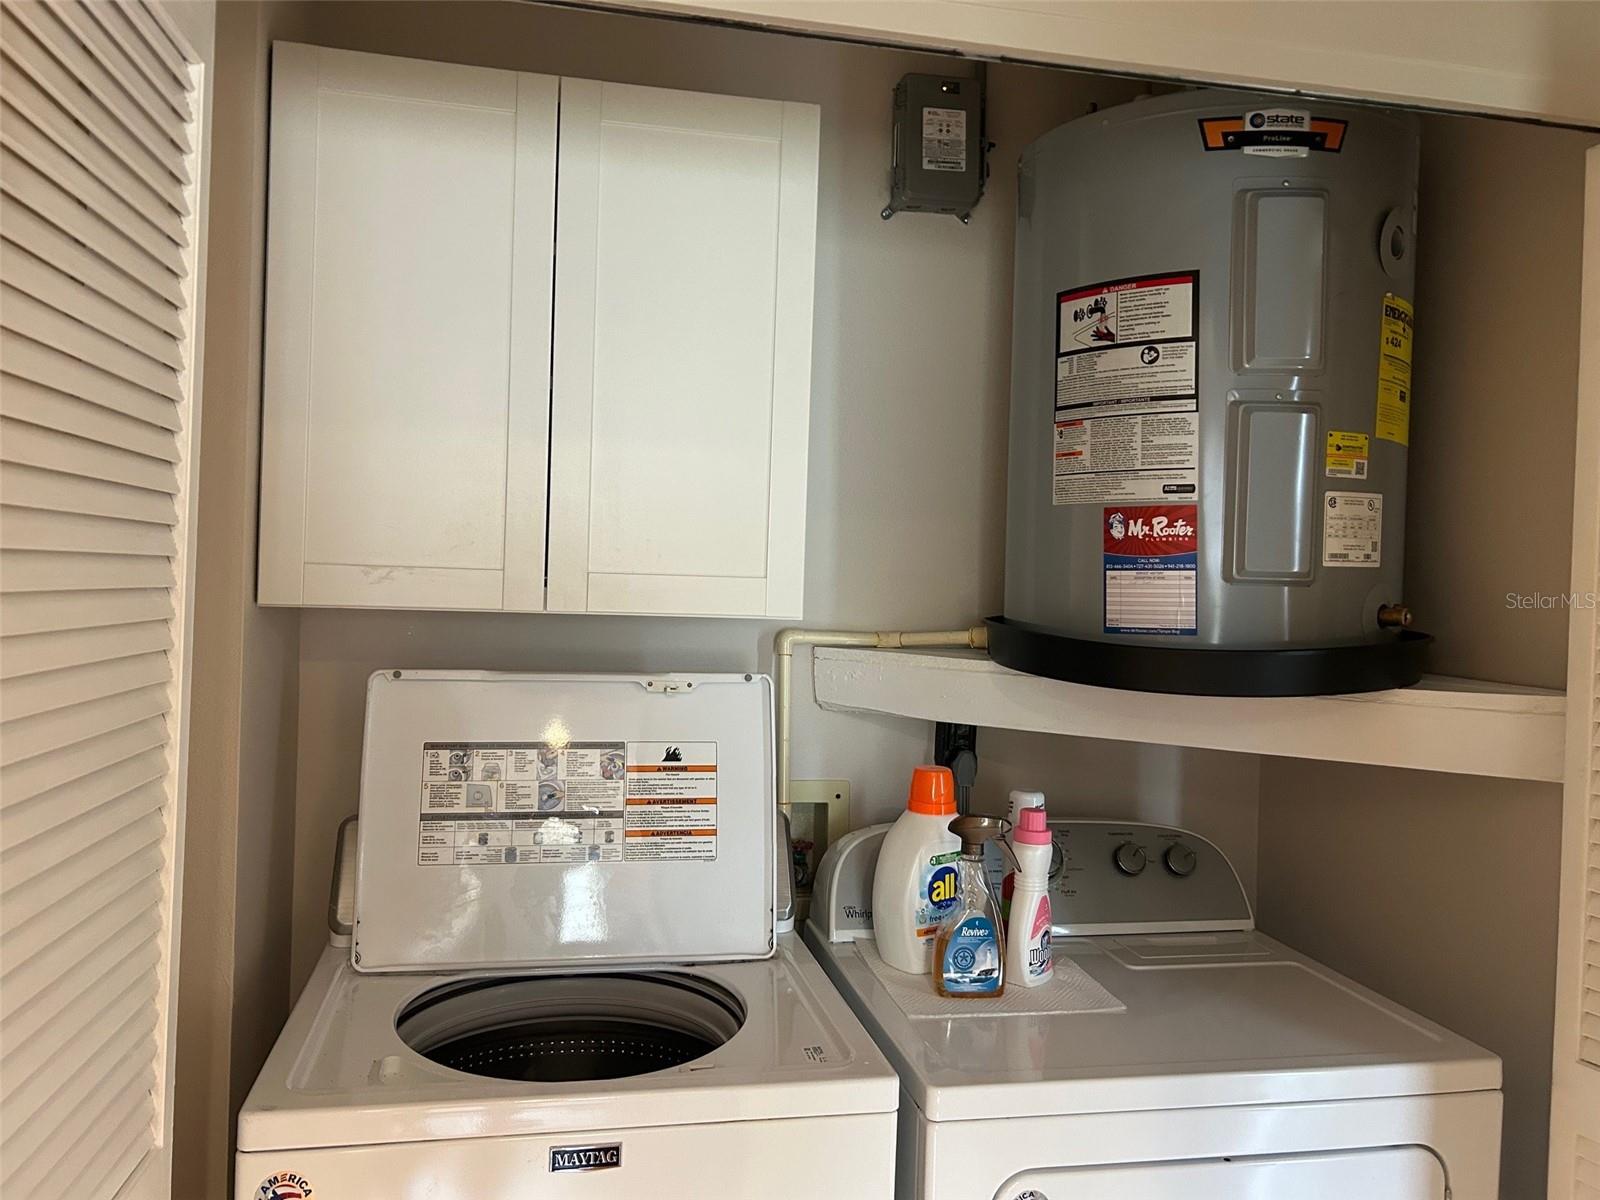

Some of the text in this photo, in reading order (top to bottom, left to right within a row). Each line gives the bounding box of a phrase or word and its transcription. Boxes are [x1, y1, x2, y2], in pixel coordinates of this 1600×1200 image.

[1266, 114, 1305, 124] state
[1109, 282, 1137, 292] DANGER
[1127, 516, 1194, 539] Mr. Rooter
[931, 872, 955, 902] all
[929, 914, 942, 923] free
[554, 1149, 618, 1168] MAYTAG
[260, 1172, 313, 1198] AMERICA
